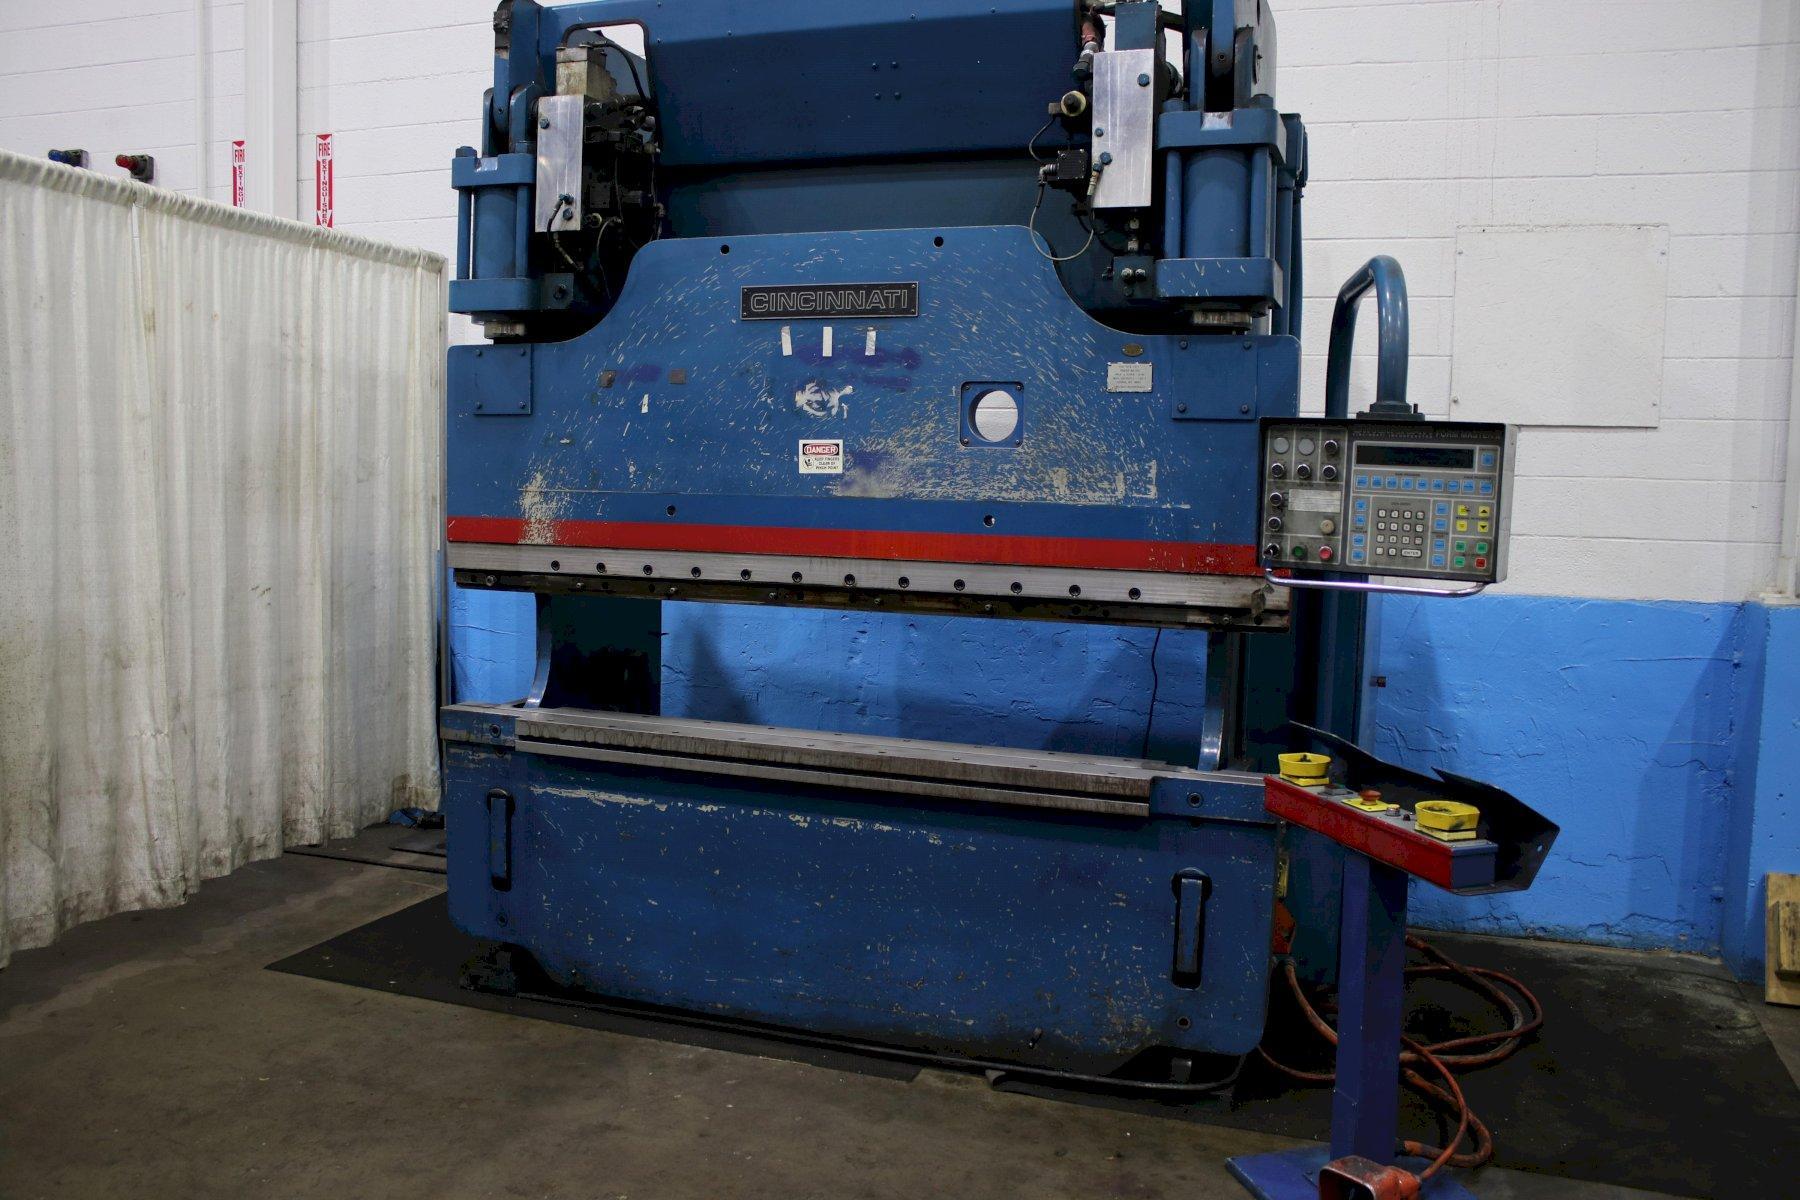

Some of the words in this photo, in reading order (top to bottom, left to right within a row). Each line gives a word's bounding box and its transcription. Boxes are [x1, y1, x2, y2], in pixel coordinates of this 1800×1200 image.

[318, 142, 330, 157] FIRE
[750, 289, 908, 312] CINCINNATI
[806, 446, 836, 454] DANGER
